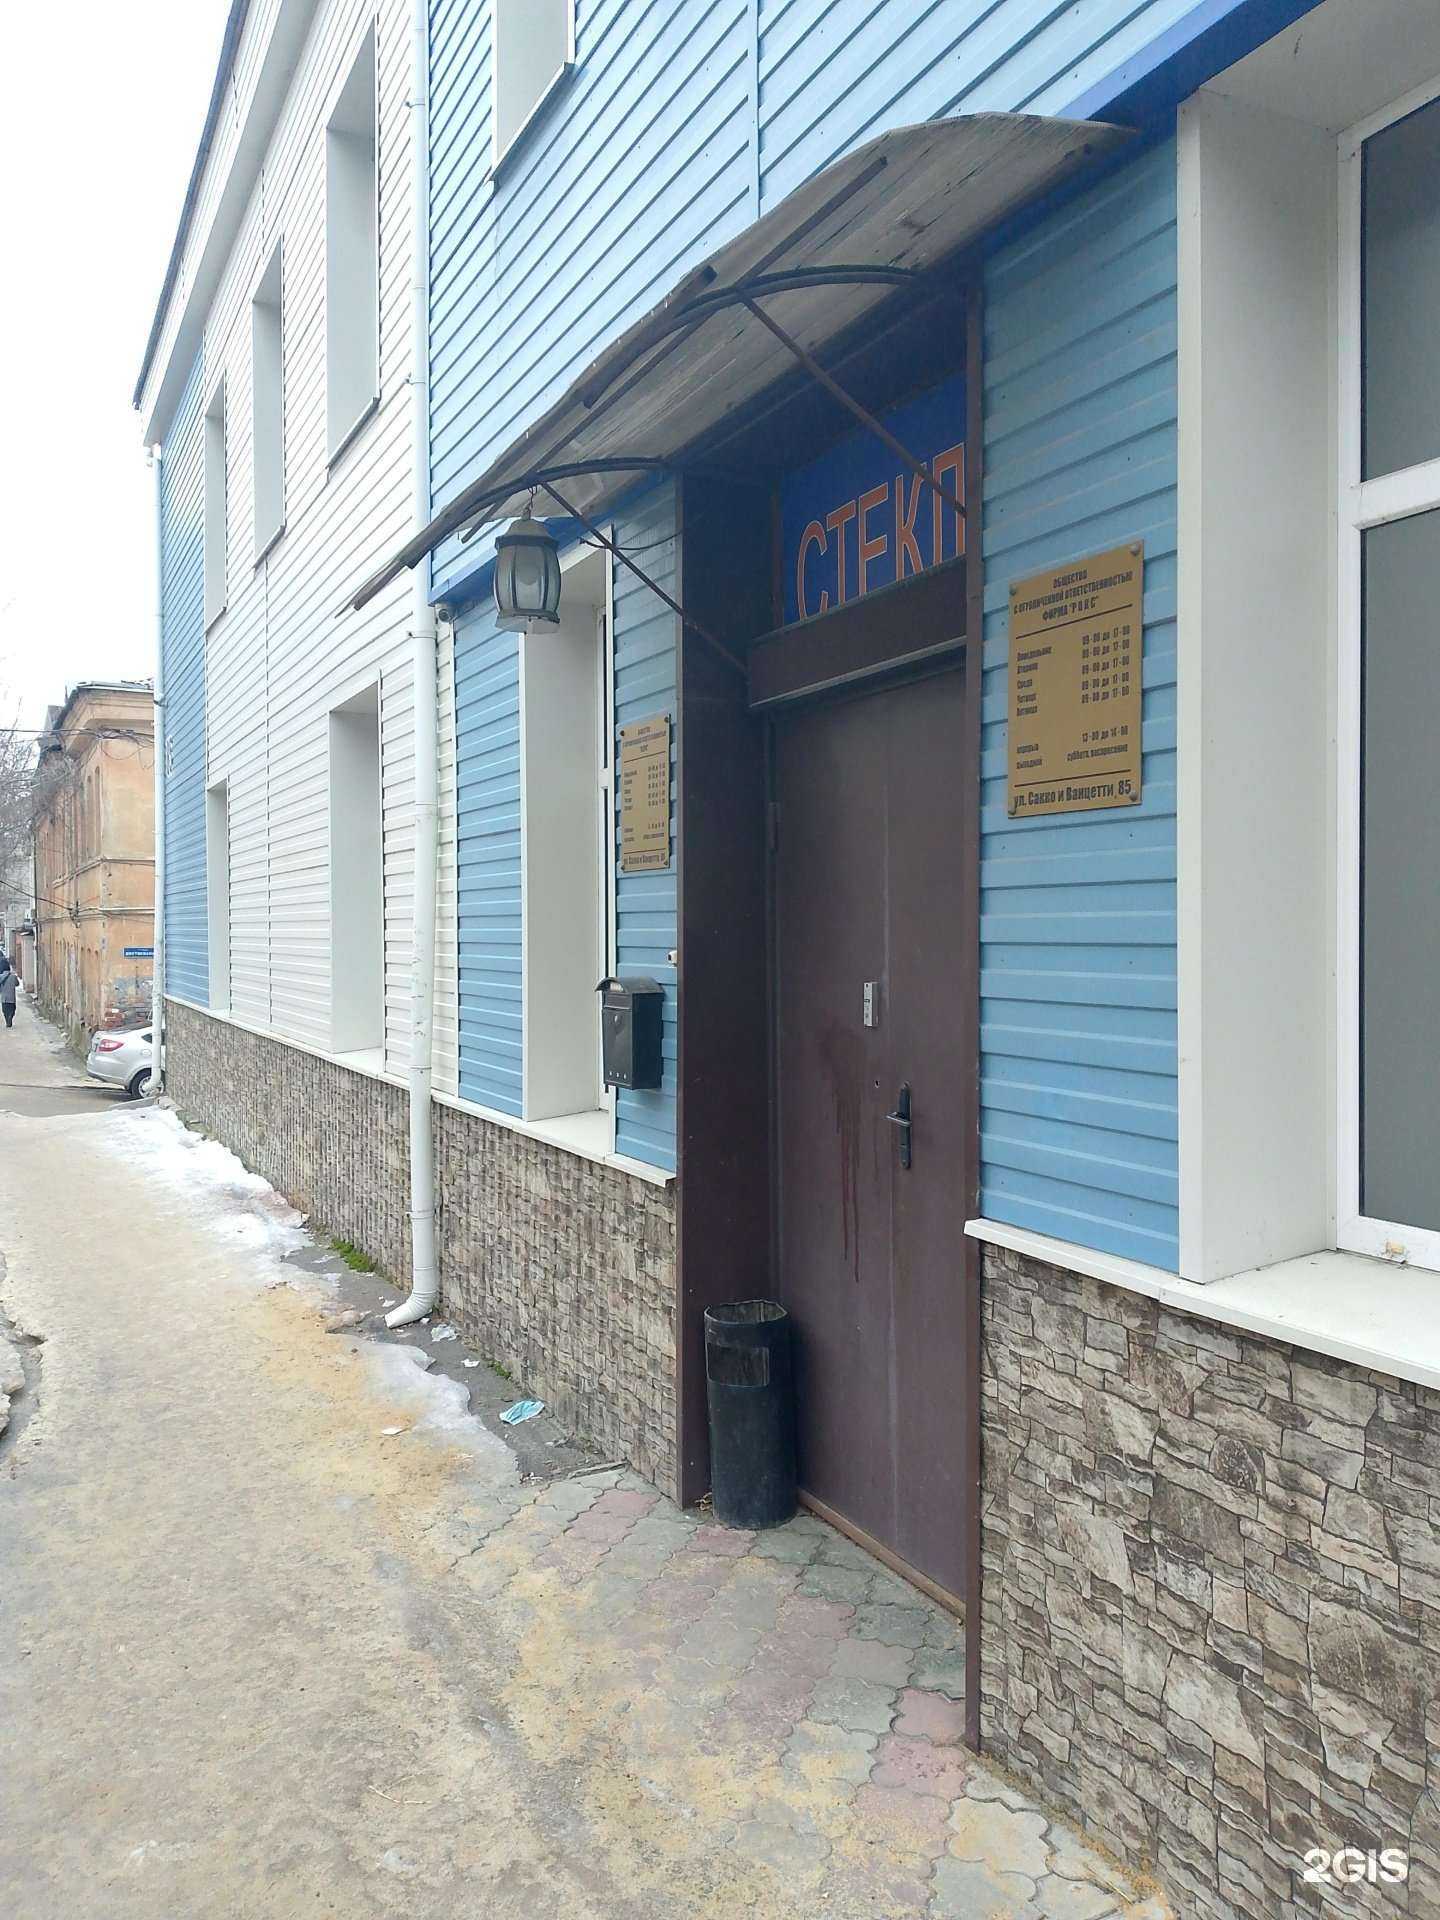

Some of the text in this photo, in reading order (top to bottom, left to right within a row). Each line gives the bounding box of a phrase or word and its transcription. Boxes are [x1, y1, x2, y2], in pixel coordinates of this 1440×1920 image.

[1053, 569, 1088, 588] ОБЩЕСТВО
[1028, 790, 1056, 805] Сакко
[1057, 789, 1065, 802] и
[1118, 779, 1132, 796] 85
